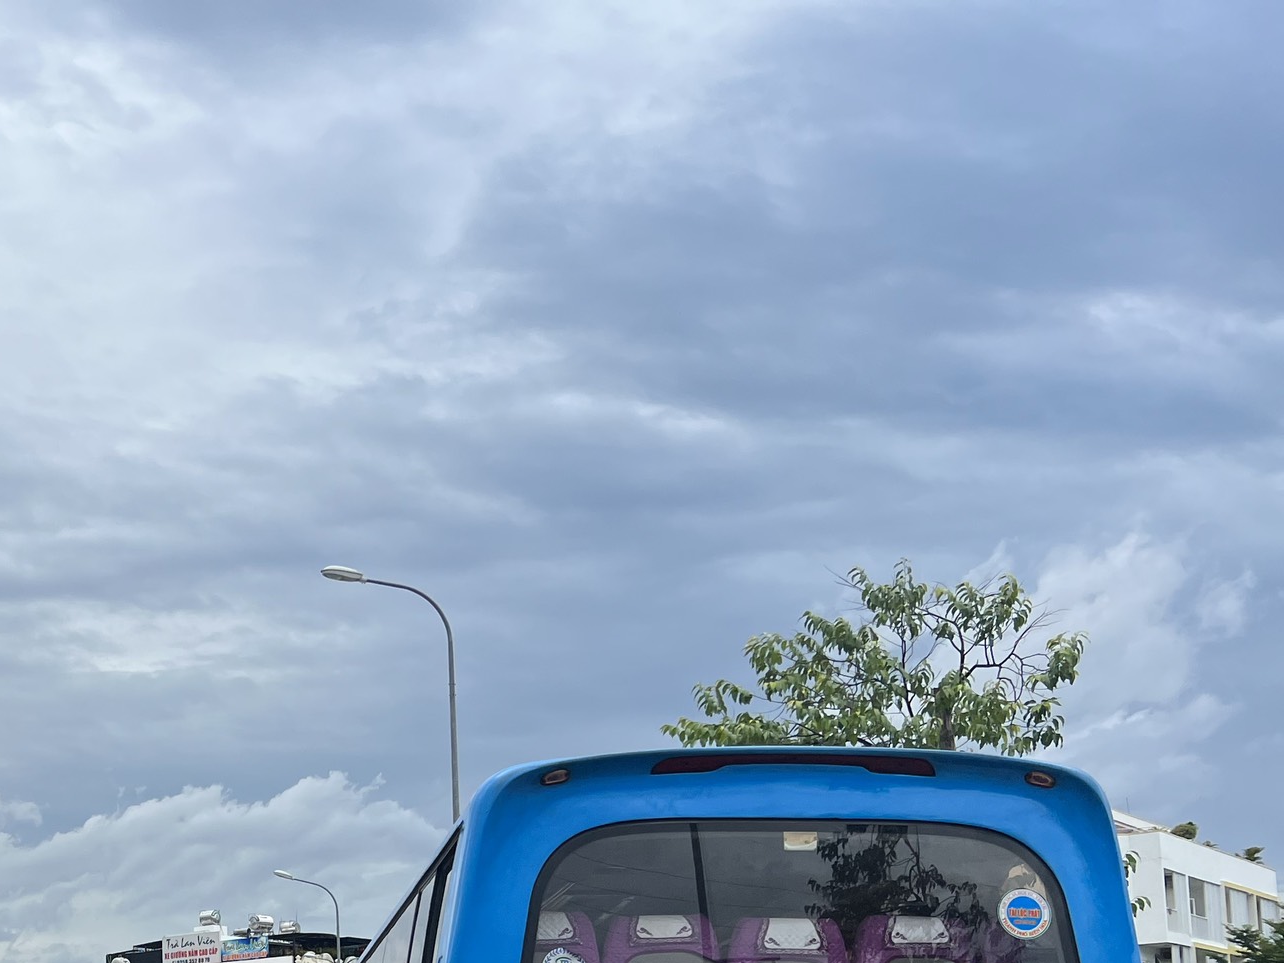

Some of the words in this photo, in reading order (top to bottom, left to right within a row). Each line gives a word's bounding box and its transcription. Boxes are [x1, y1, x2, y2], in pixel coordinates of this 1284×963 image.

[166, 938, 179, 949] Trà
[181, 937, 195, 948] Lan
[197, 935, 216, 946] Viên
[199, 948, 208, 957] CAO
